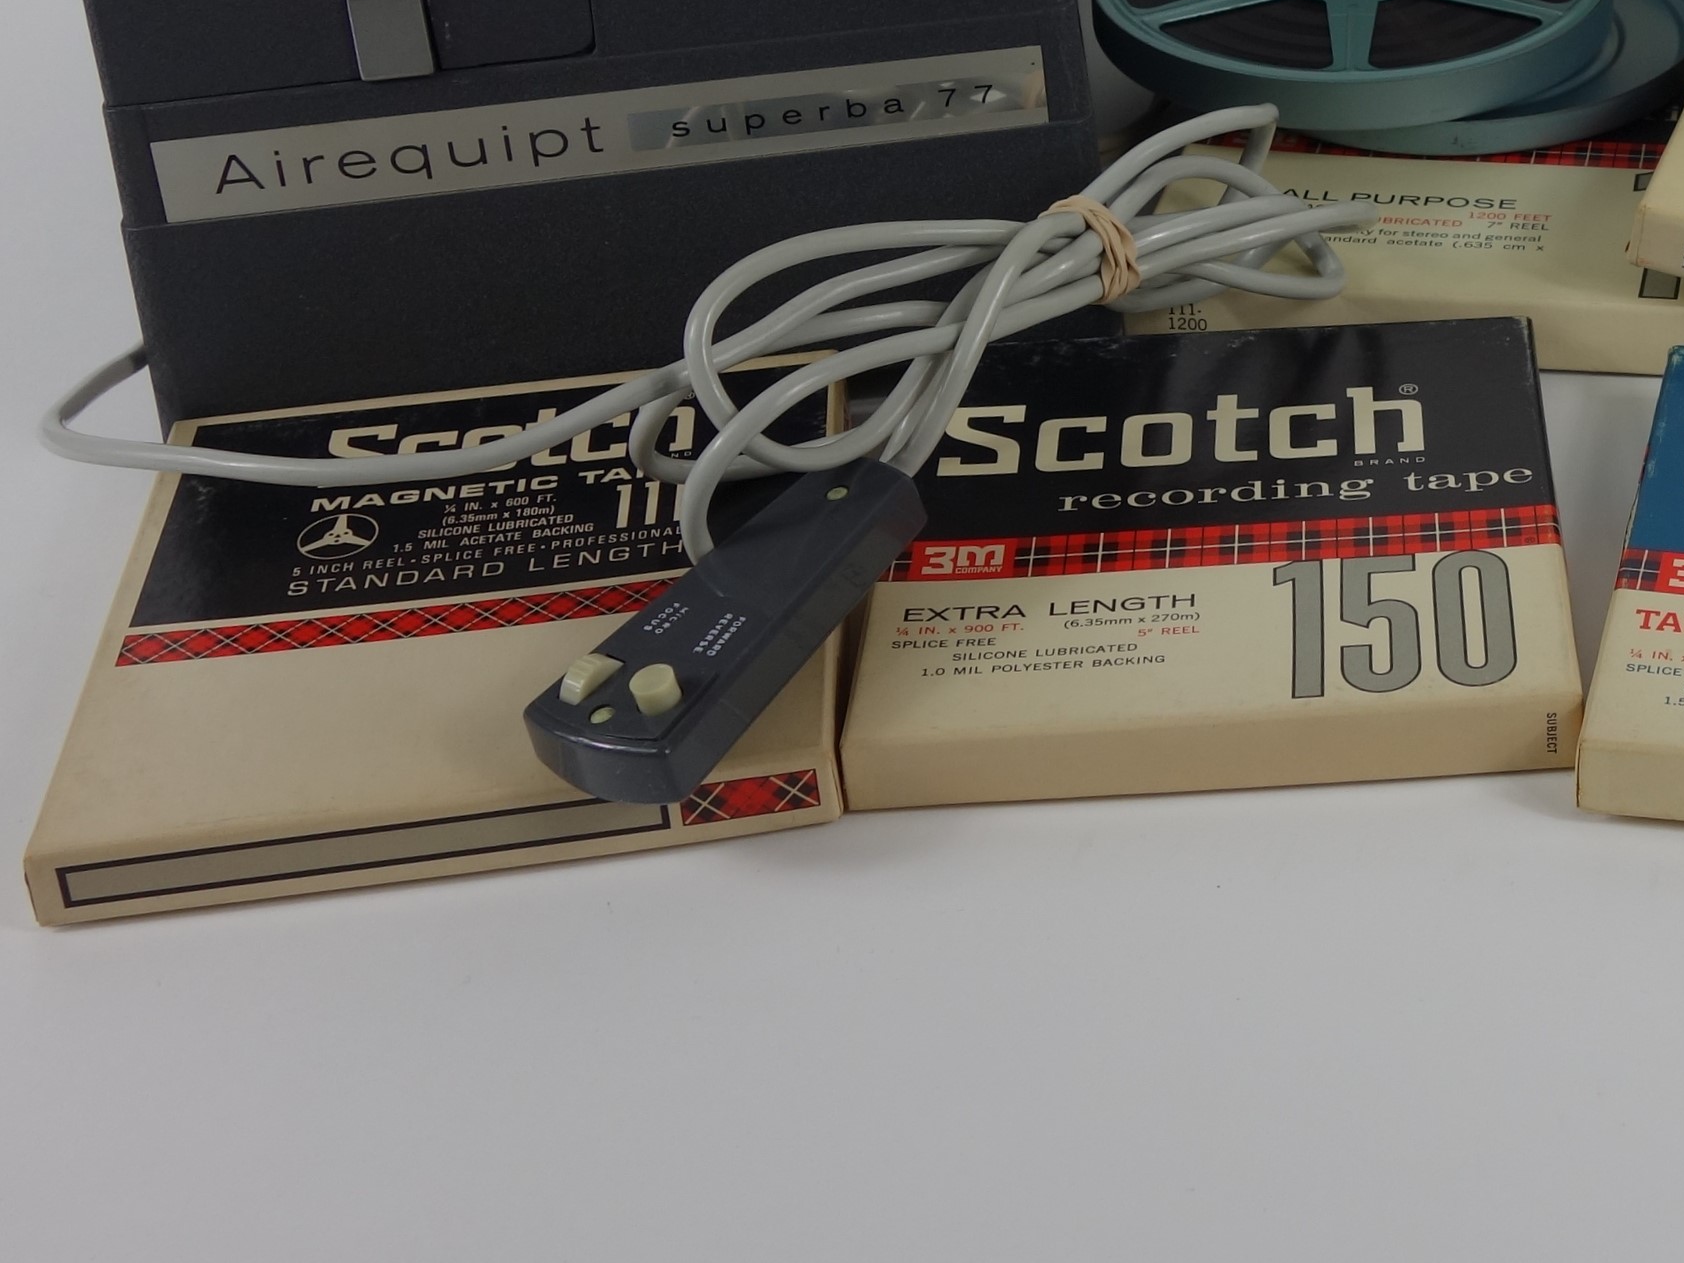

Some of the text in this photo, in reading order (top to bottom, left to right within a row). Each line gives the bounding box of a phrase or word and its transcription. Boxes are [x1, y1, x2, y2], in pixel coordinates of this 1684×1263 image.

[215, 116, 607, 196] Airequipt
[671, 95, 905, 139] superba
[1350, 191, 1517, 210] PURPOSE
[1513, 213, 1553, 223] FEET
[1485, 233, 1542, 244] general
[1168, 317, 1208, 331] 1200
[937, 385, 1426, 477] Scotch
[1354, 456, 1426, 467] BRAND
[310, 475, 559, 513] MAGNETIC
[505, 495, 530, 507] 600
[1057, 464, 1533, 513] recording tape
[418, 513, 574, 540] SILICONE LUBRICATED
[423, 522, 595, 550] MIL ACETATE BACKING
[287, 539, 683, 597] STANDARD LENGTH
[309, 561, 355, 576] INCH
[921, 544, 1006, 575] 3M
[954, 565, 1004, 575] COMPANY
[643, 602, 680, 631] FOCUS
[655, 606, 690, 634] MICRO
[902, 593, 1196, 623] EXTRA LENGTH
[692, 613, 733, 654] REVERSE
[706, 616, 747, 656] FORWARD
[891, 624, 1200, 649] SPLICE FREE REEL
[963, 623, 994, 634] 900
[1272, 549, 1518, 699] 150
[952, 642, 1138, 662] SILICONE LUBRICATED
[953, 654, 1166, 676] MIL POLYESTER BACKING
[1625, 663, 1682, 678] SPLICE
[1546, 711, 1559, 756] SUBJECT
